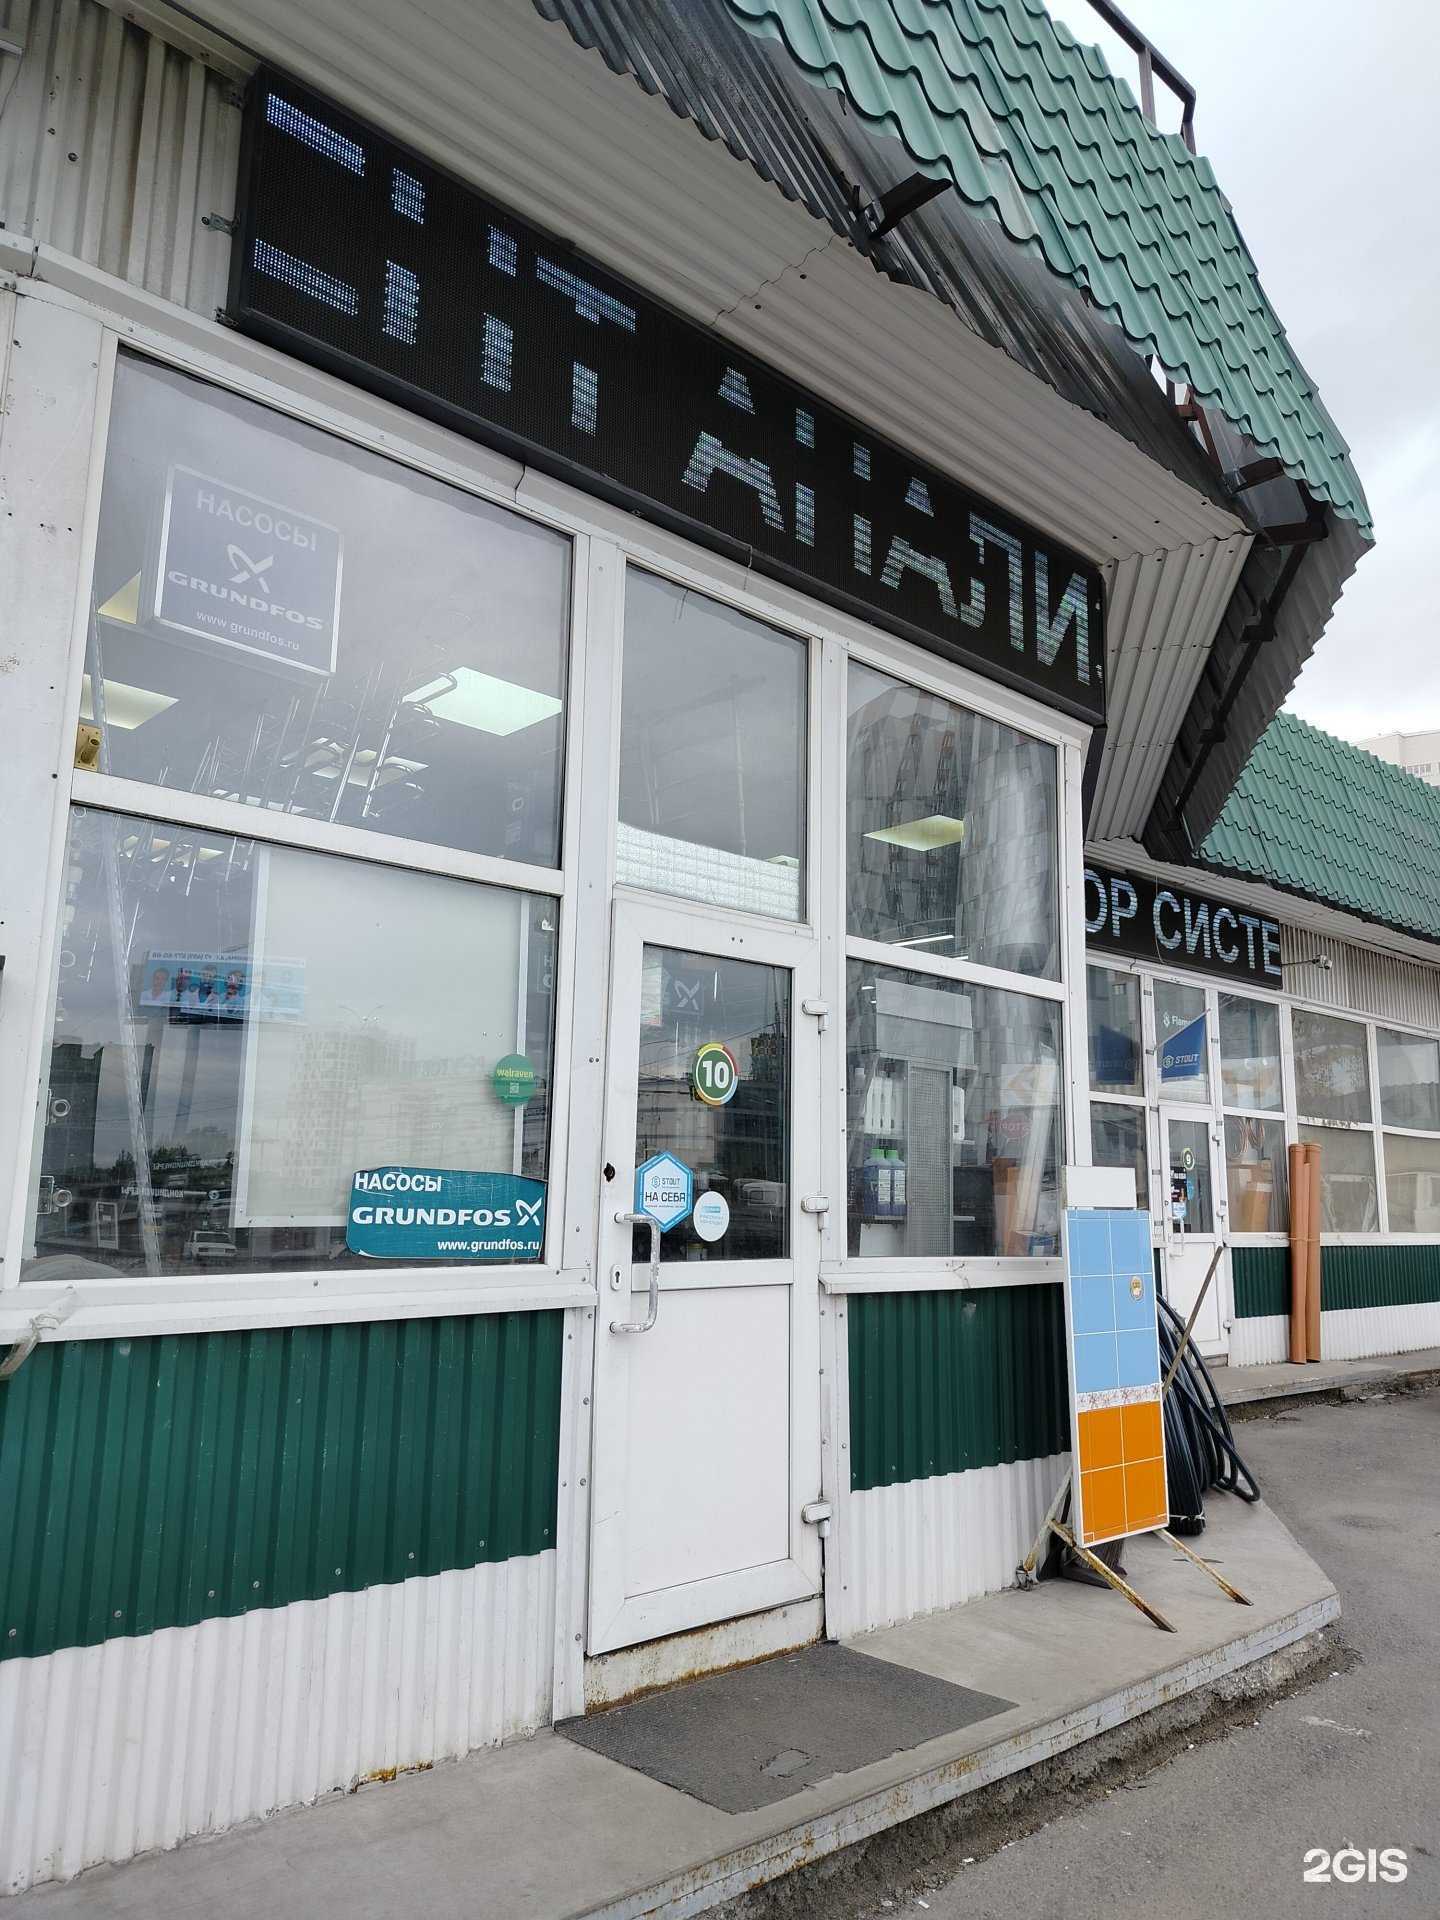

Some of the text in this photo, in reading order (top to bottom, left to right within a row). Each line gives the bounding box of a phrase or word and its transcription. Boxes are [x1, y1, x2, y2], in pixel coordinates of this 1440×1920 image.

[196, 489, 318, 552] НАСОСЫ
[168, 570, 325, 631] GRUNDFOS
[1152, 891, 1282, 977] СИСТЕ
[1175, 1053, 1200, 1064] STOUT
[703, 1060, 730, 1089] 10
[1186, 1154, 1191, 1165] 9
[354, 1172, 442, 1193] НАСОСЫ
[661, 1177, 681, 1186] STOUT
[645, 1191, 686, 1203] НА СЕБЯ
[352, 1206, 511, 1226] GRUNDFOS
[437, 1238, 541, 1252] www.grundfos.ru
